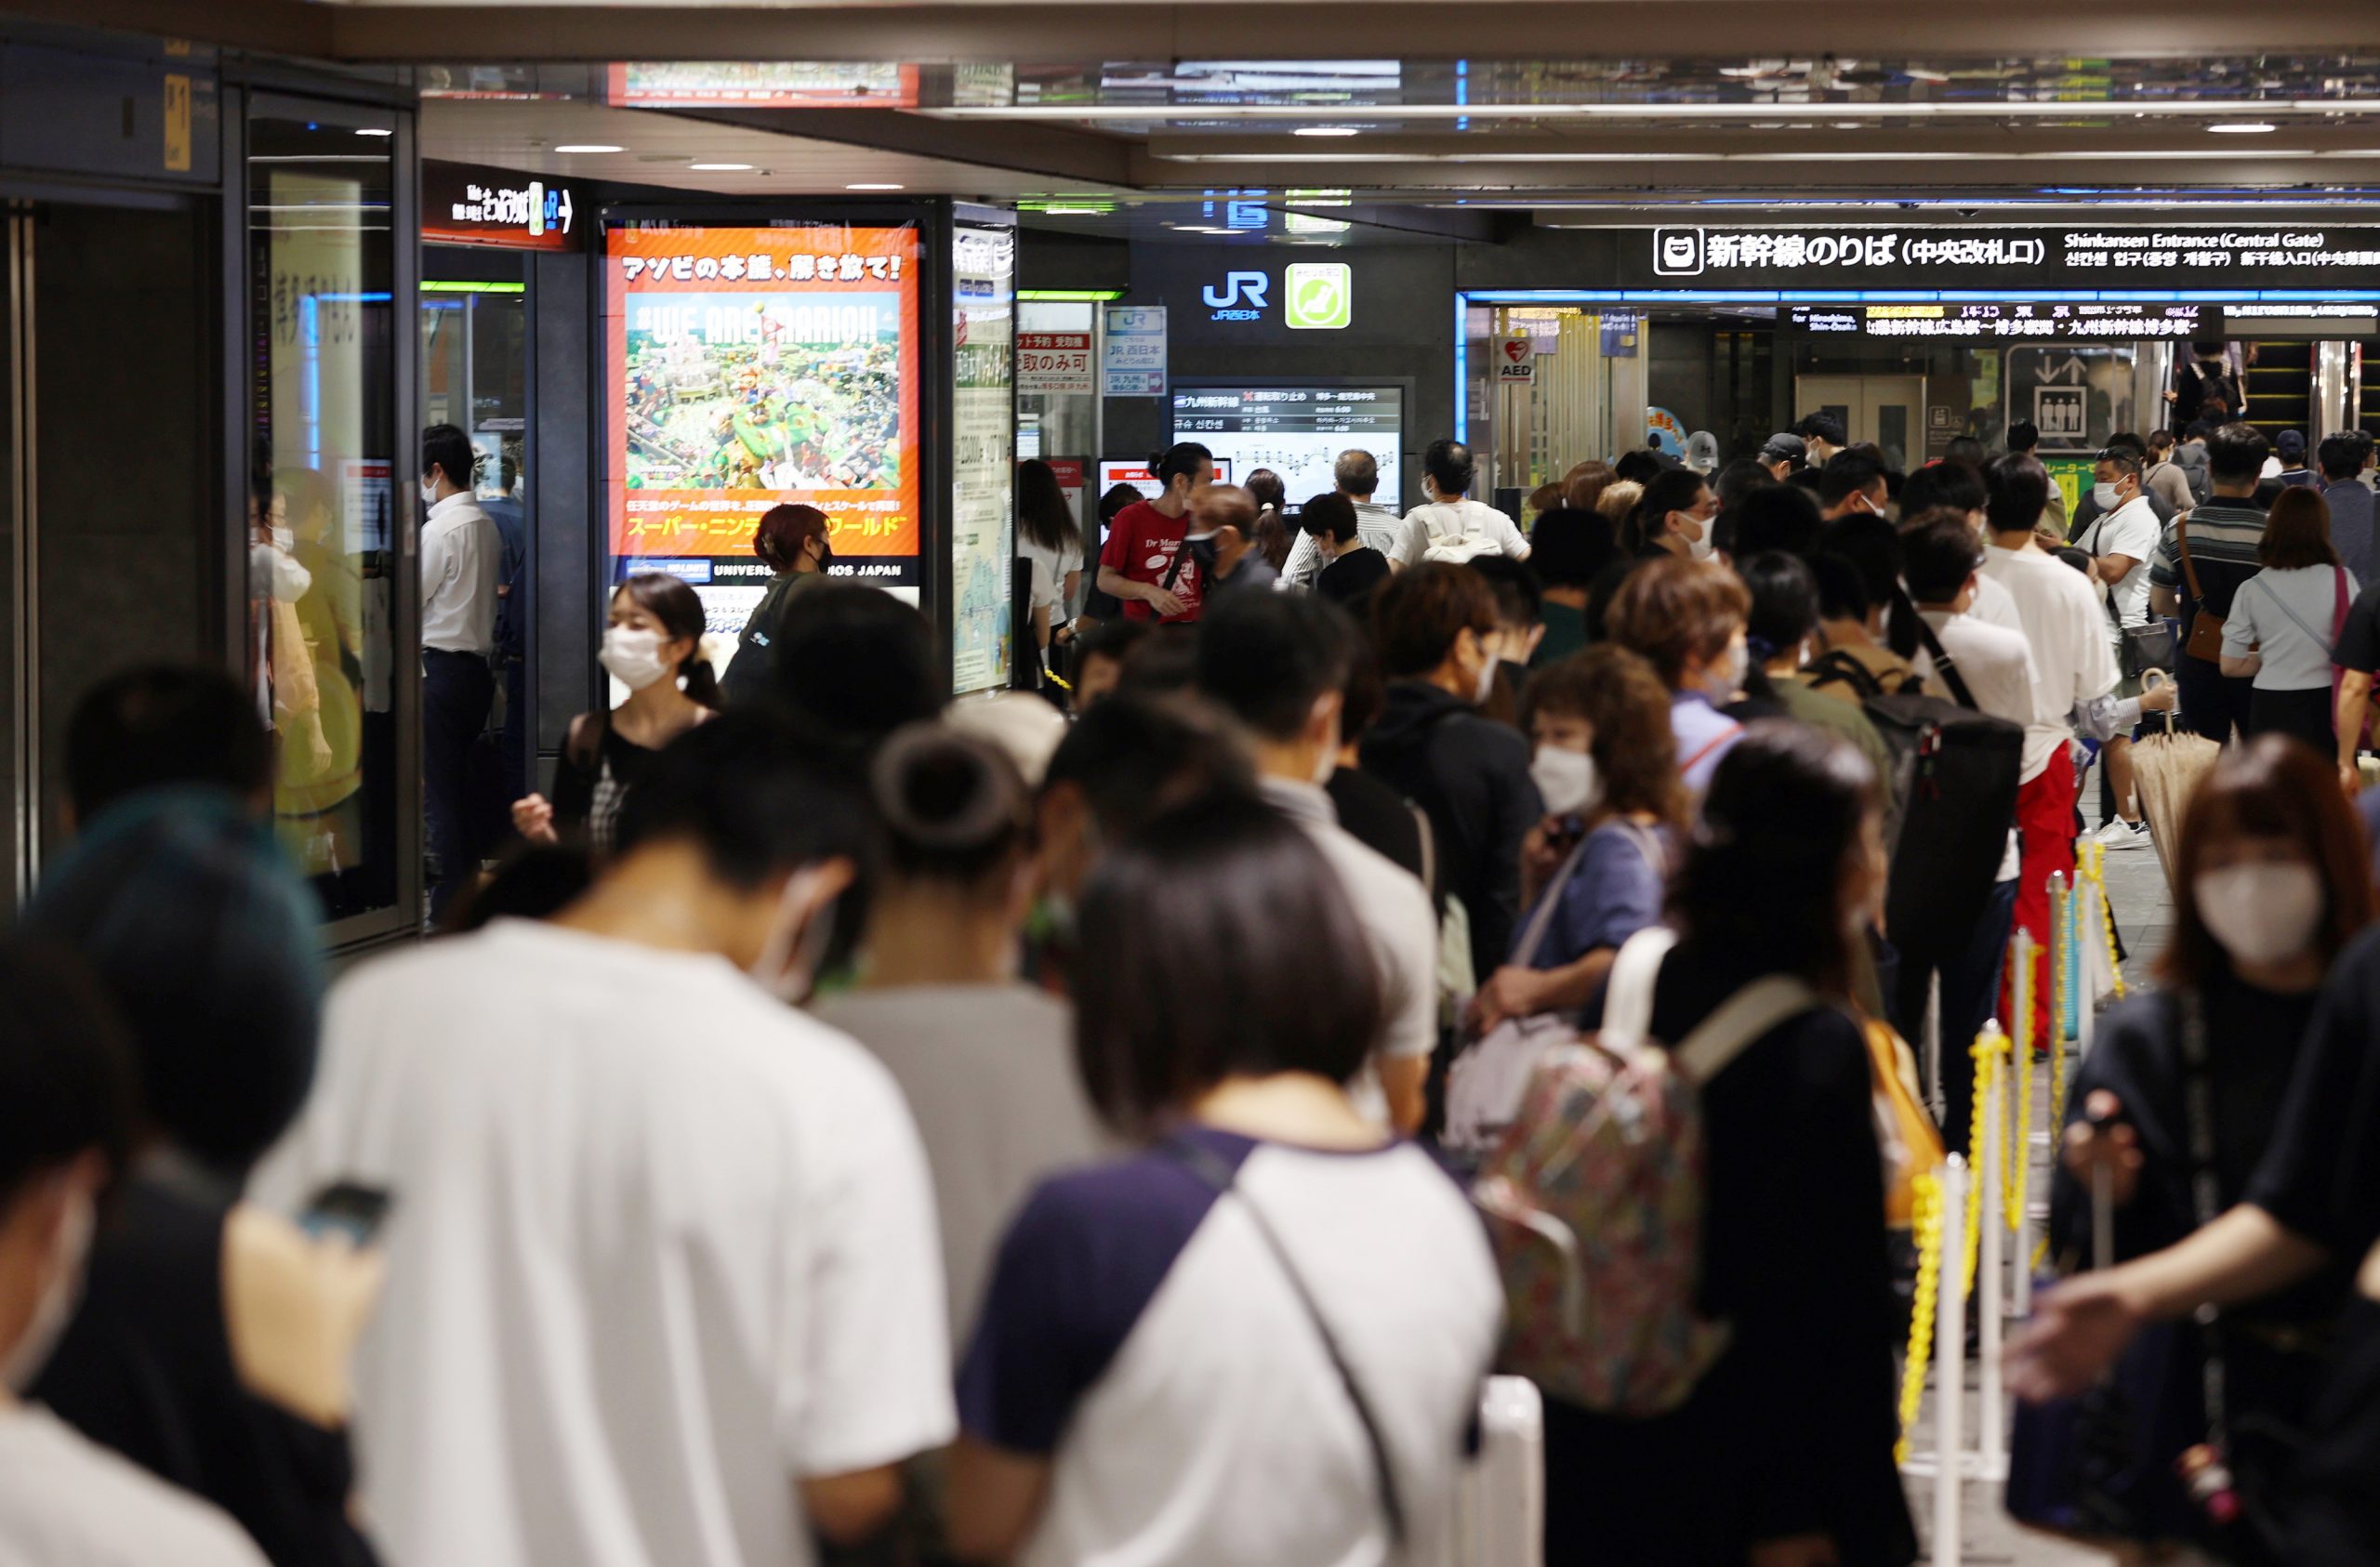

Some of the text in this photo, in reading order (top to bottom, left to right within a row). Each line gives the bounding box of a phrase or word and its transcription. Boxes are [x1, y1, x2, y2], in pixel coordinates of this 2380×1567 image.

[2064, 232, 2149, 248] Shinkansen
[2281, 232, 2324, 248] Gate)
[2064, 251, 2109, 267] 신칸센
[1203, 270, 1269, 309] JR
[1124, 312, 1145, 325] JR
[1210, 309, 1261, 321] JR西日本
[1792, 314, 1806, 323] for
[1110, 345, 1124, 355] JR
[1501, 365, 1531, 375] AED
[1145, 539, 1158, 547] Dr
[713, 564, 777, 576] UNIVERS
[856, 564, 902, 576] JAPAN
